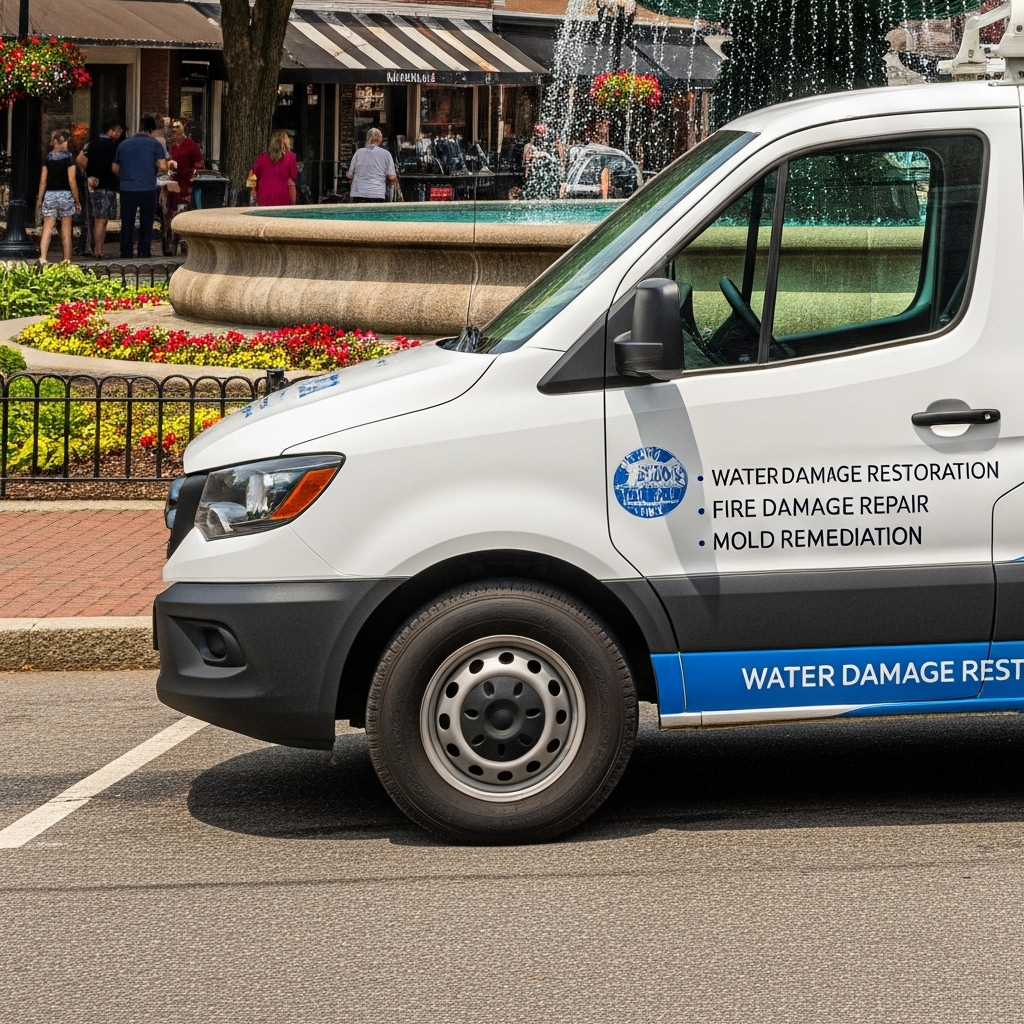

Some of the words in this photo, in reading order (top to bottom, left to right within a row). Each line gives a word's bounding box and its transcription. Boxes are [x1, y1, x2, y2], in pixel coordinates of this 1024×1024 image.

[711, 467, 779, 487] WATER
[782, 465, 863, 485] DAMAGE
[867, 460, 999, 483] RESTORATION
[713, 498, 757, 519] FIRE
[763, 496, 855, 517] DAMAGE
[860, 494, 929, 515] REPAIR
[713, 530, 775, 551] MOLD
[781, 525, 922, 549] REMEDIATION
[741, 664, 835, 690] WATER
[842, 660, 955, 686] DAMAGE
